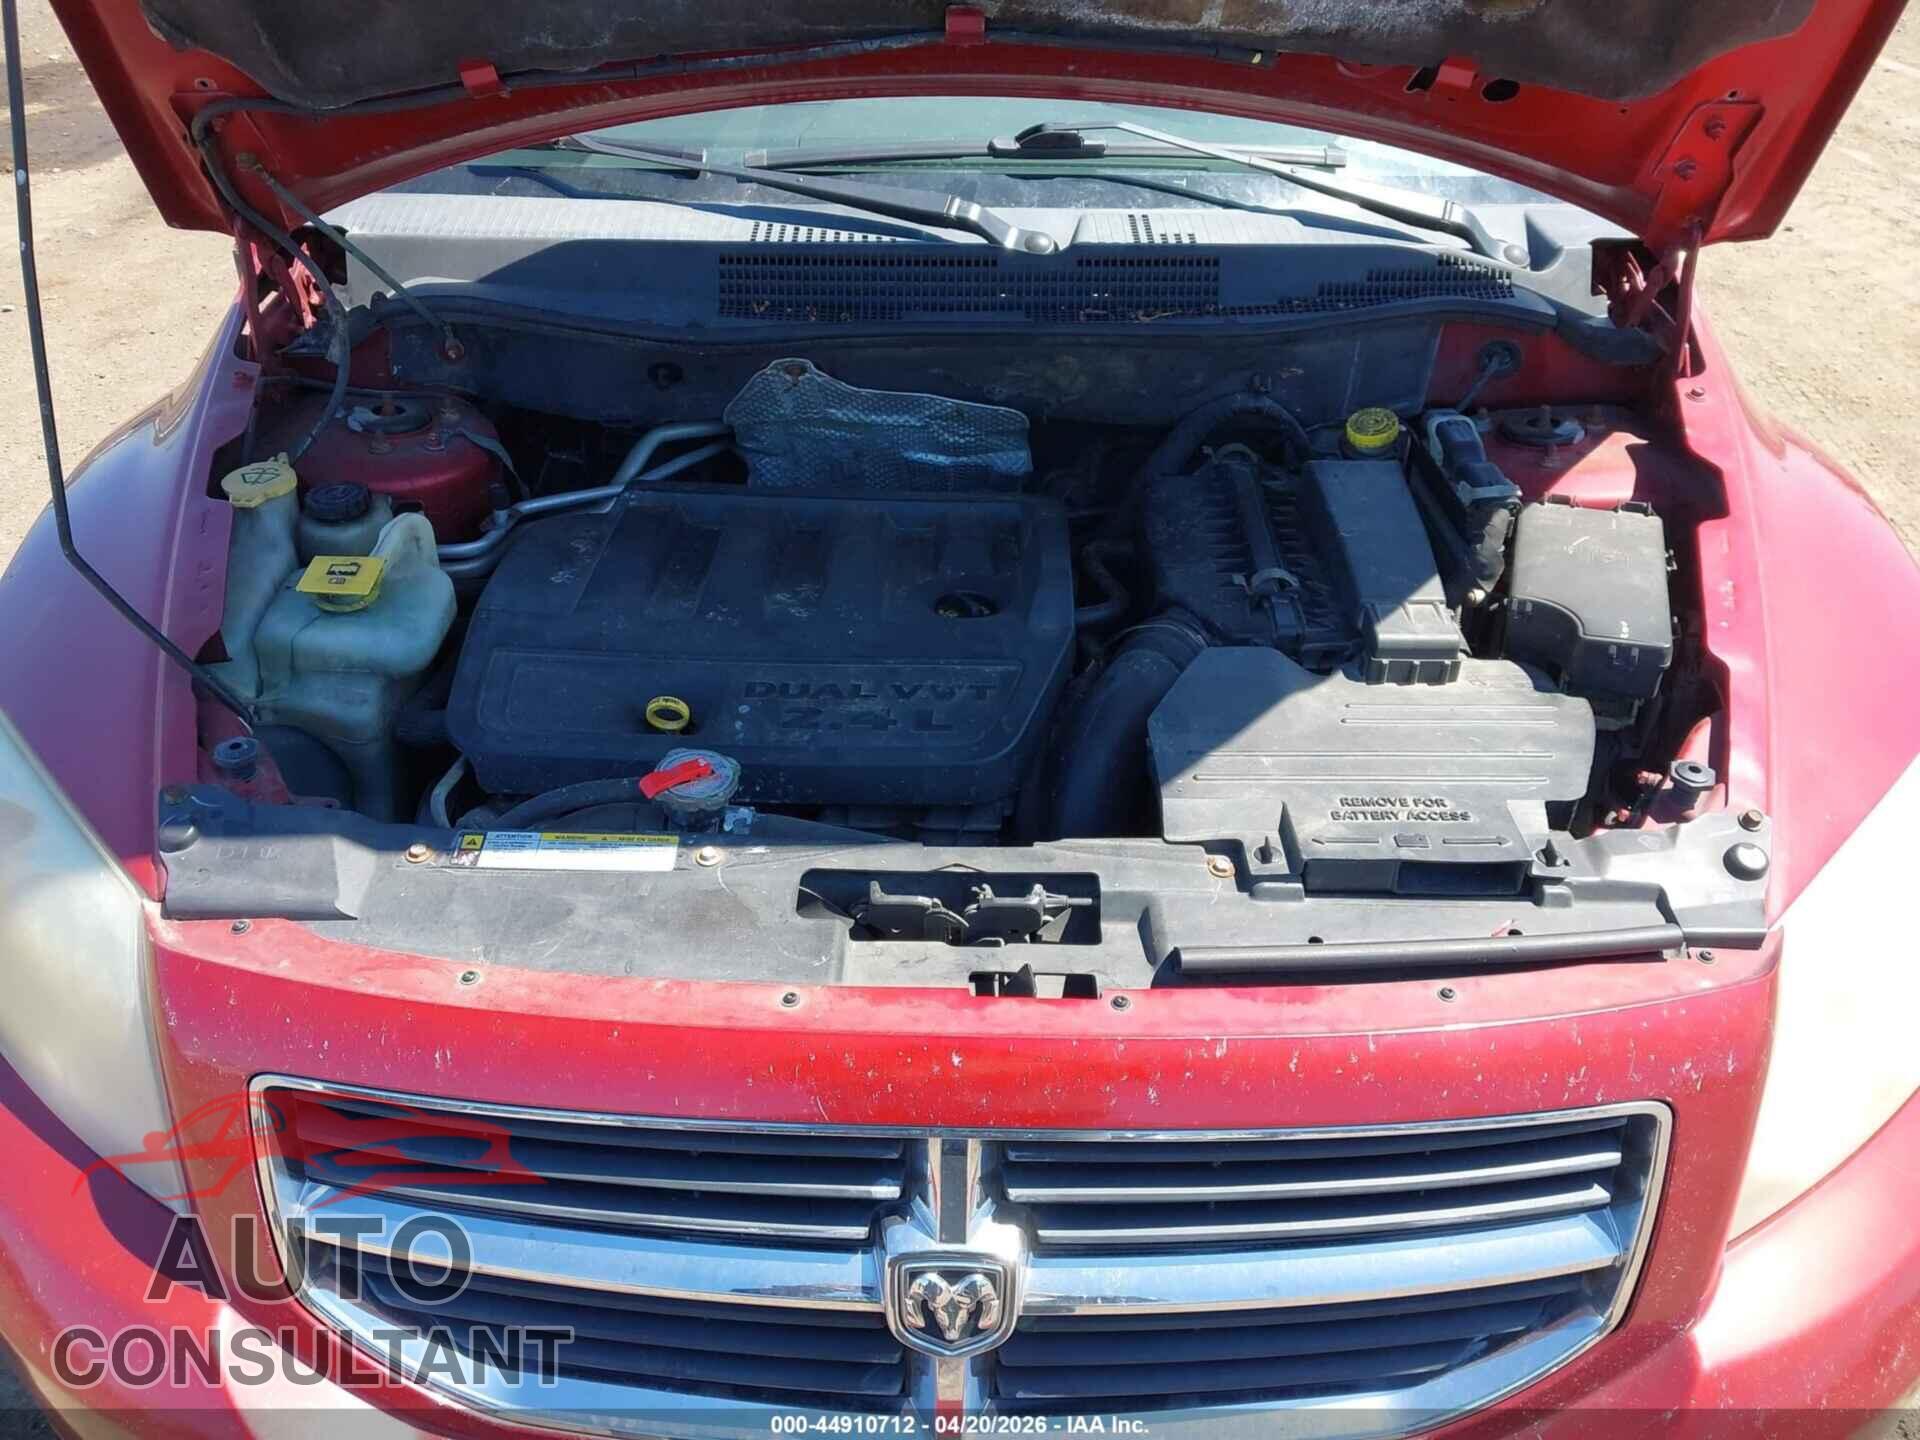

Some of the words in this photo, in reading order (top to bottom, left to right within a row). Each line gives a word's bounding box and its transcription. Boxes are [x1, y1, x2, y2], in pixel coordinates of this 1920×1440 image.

[744, 680, 878, 699] DUAL
[782, 706, 898, 731] 2.4
[913, 708, 954, 731] L
[1339, 797, 1409, 808] REMOVE
[1412, 797, 1448, 808] FOR
[1330, 810, 1400, 821] BATTERY
[1406, 810, 1471, 821] ACCESS
